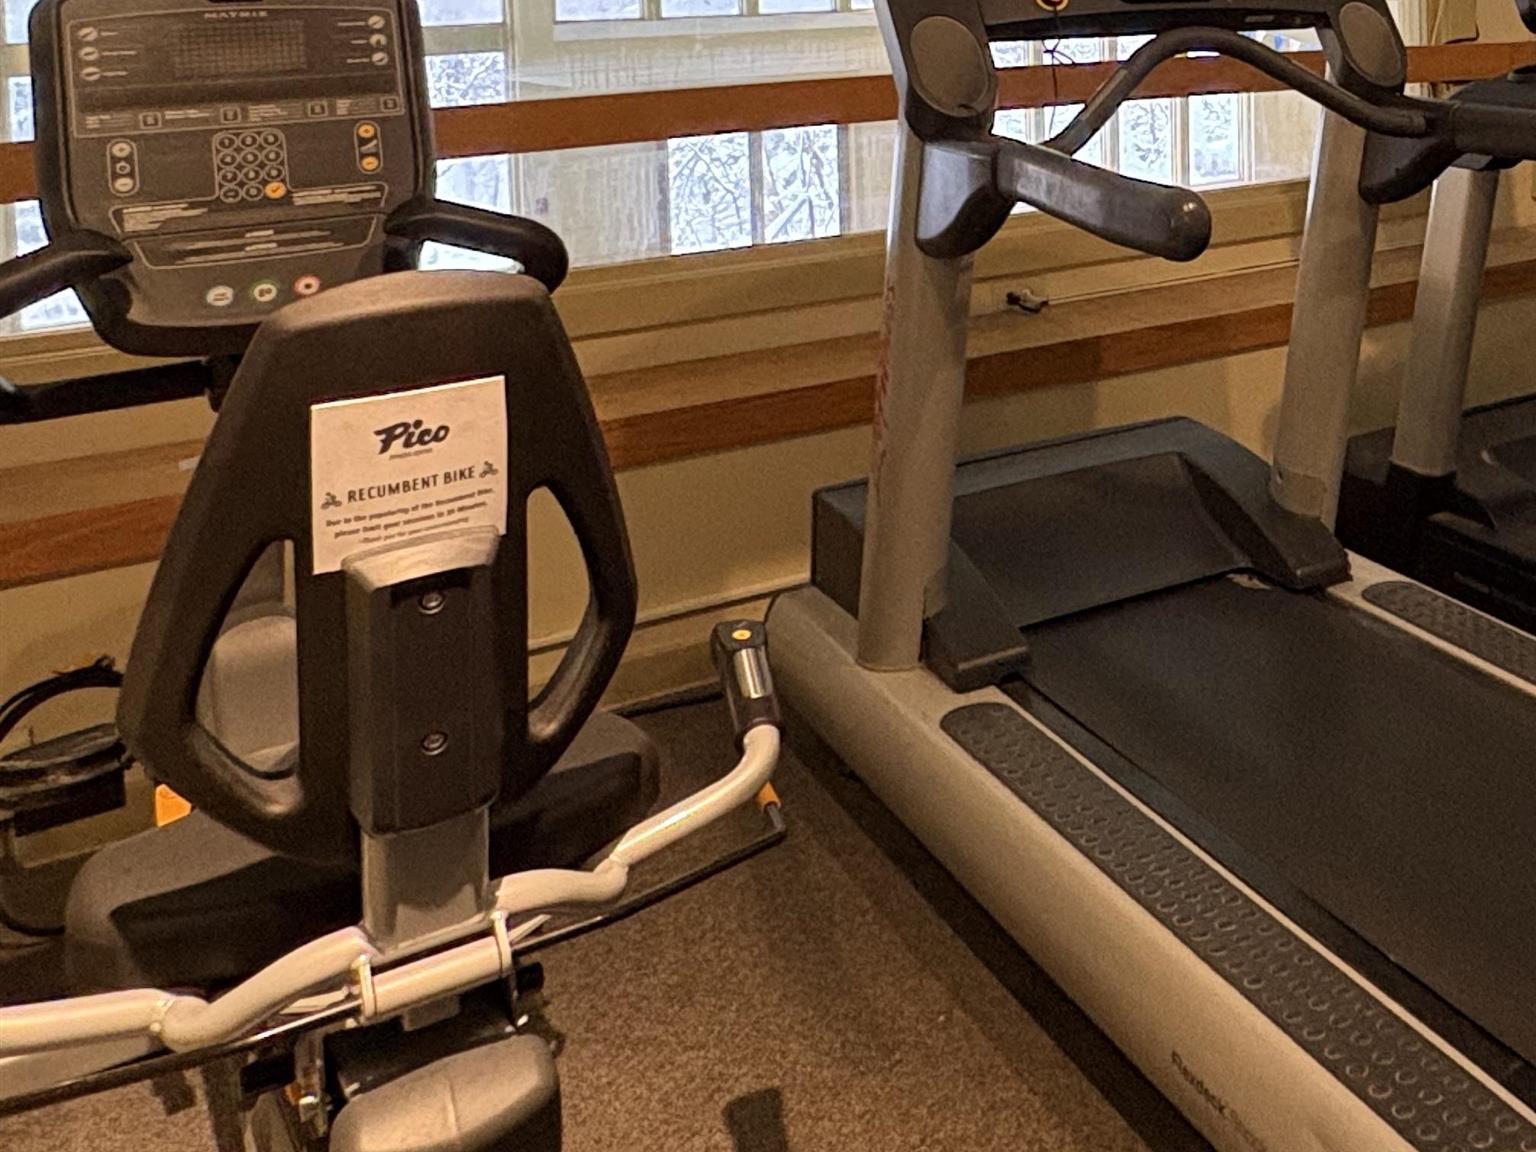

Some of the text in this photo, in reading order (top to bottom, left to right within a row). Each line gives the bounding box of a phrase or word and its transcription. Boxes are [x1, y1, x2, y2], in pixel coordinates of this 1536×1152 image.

[374, 419, 450, 455] Pico
[347, 466, 475, 504] RECUMBENT BIKE
